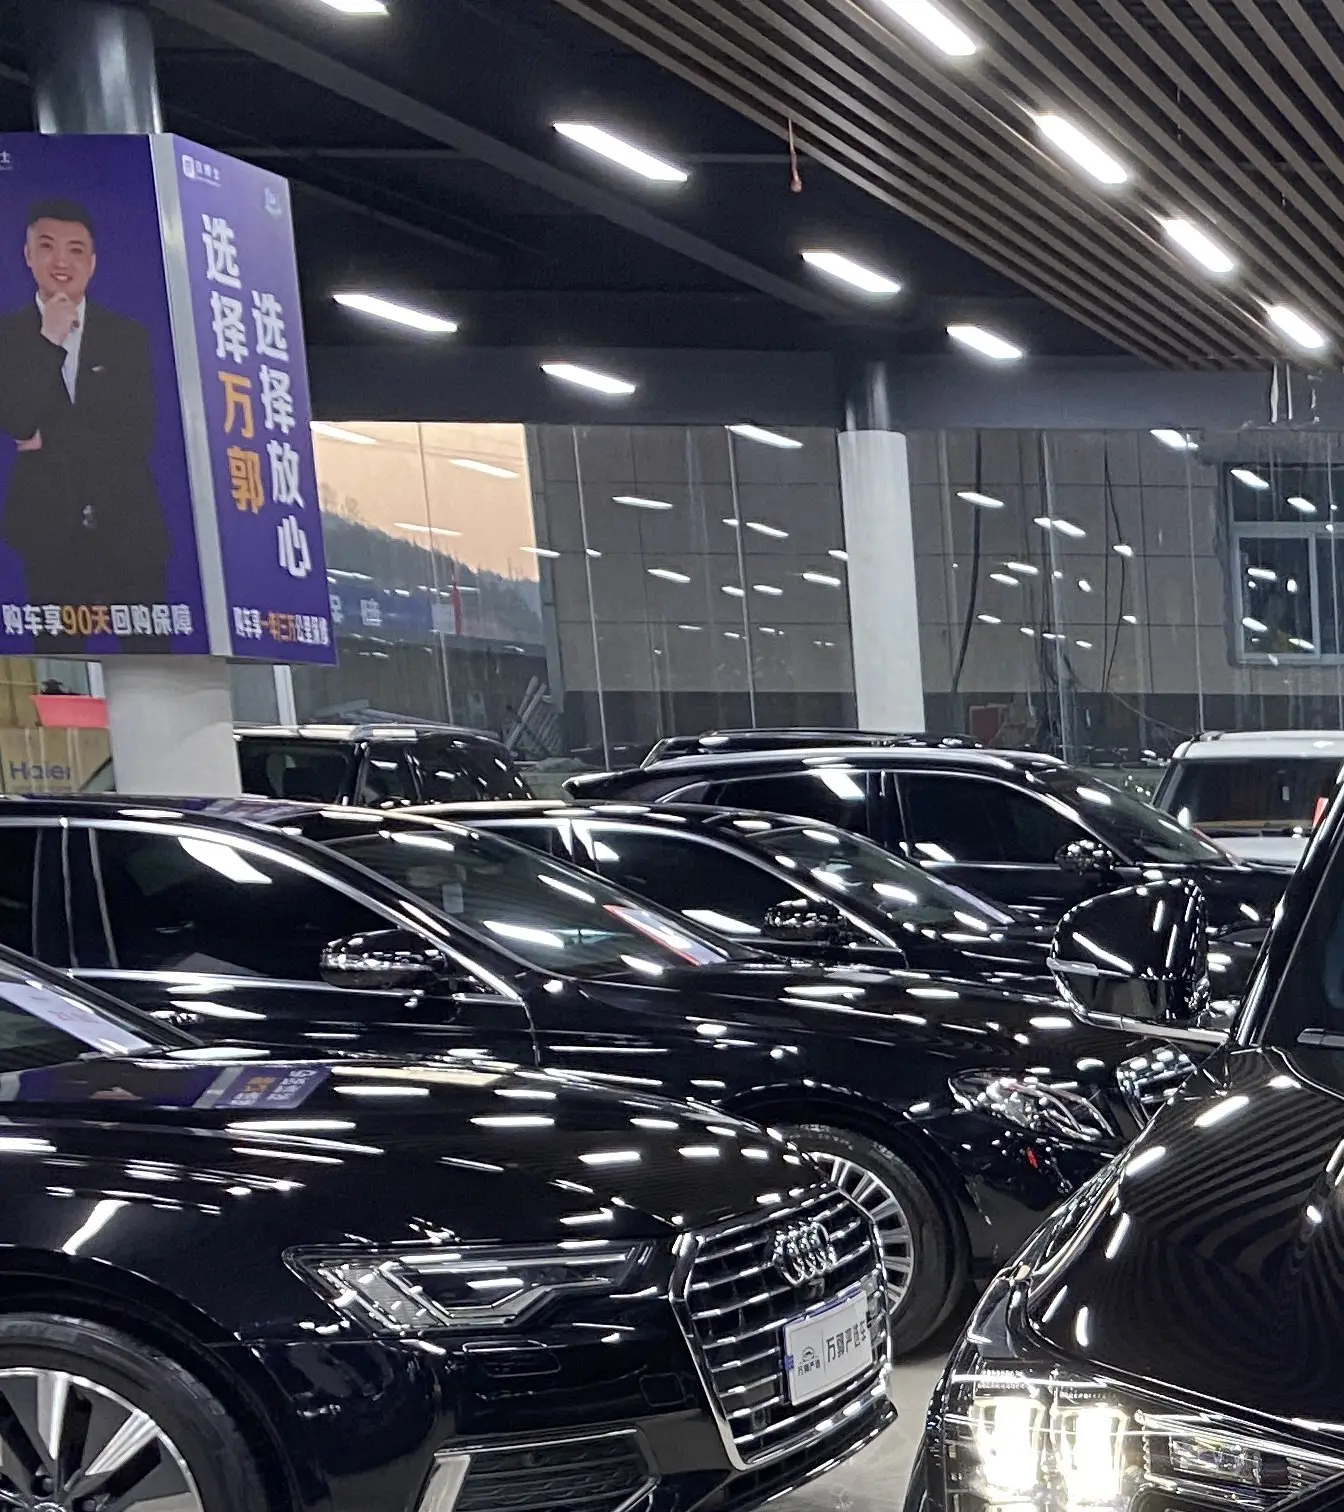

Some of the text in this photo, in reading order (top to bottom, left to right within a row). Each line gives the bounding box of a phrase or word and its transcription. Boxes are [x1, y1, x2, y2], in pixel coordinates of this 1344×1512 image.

[202, 212, 265, 513] 选择万郭
[251, 288, 312, 578] 选择放心
[1, 603, 195, 637] 购车享90天回购保障
